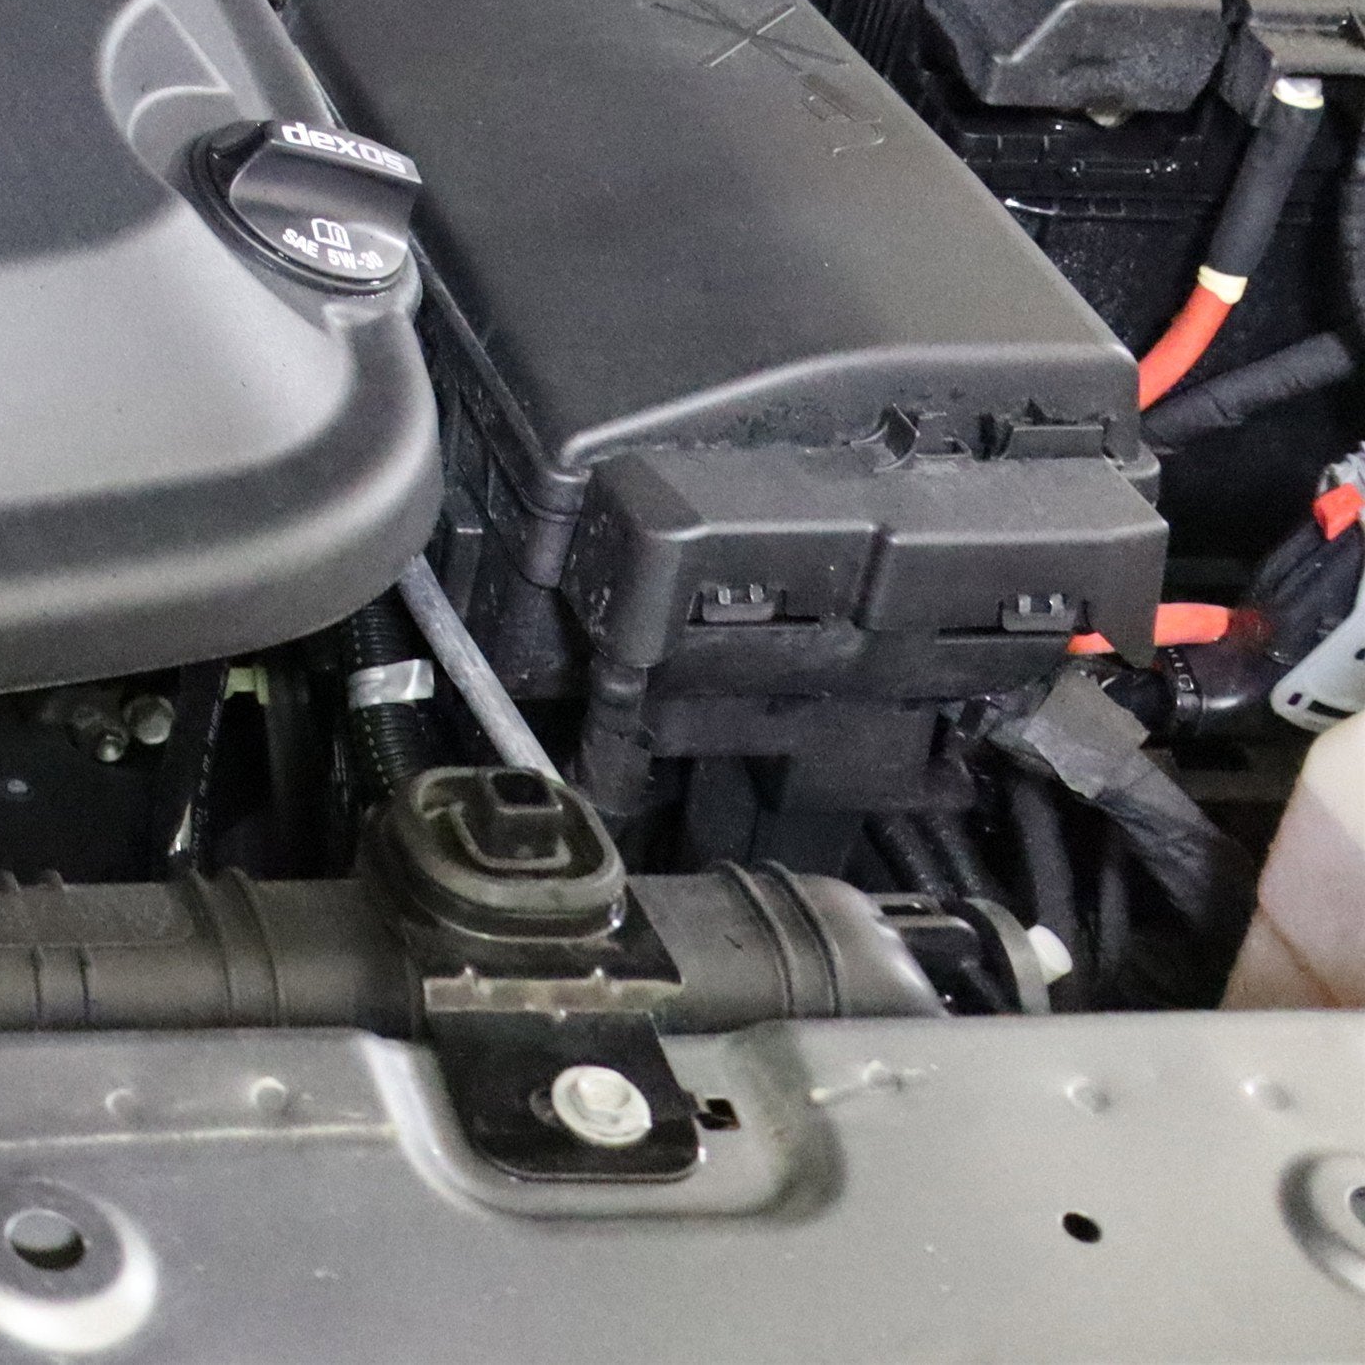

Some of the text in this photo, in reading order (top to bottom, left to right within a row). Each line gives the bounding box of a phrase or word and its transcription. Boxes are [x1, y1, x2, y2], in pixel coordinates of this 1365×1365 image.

[281, 122, 406, 174] dexos
[282, 228, 384, 271] SAE 5W-30
